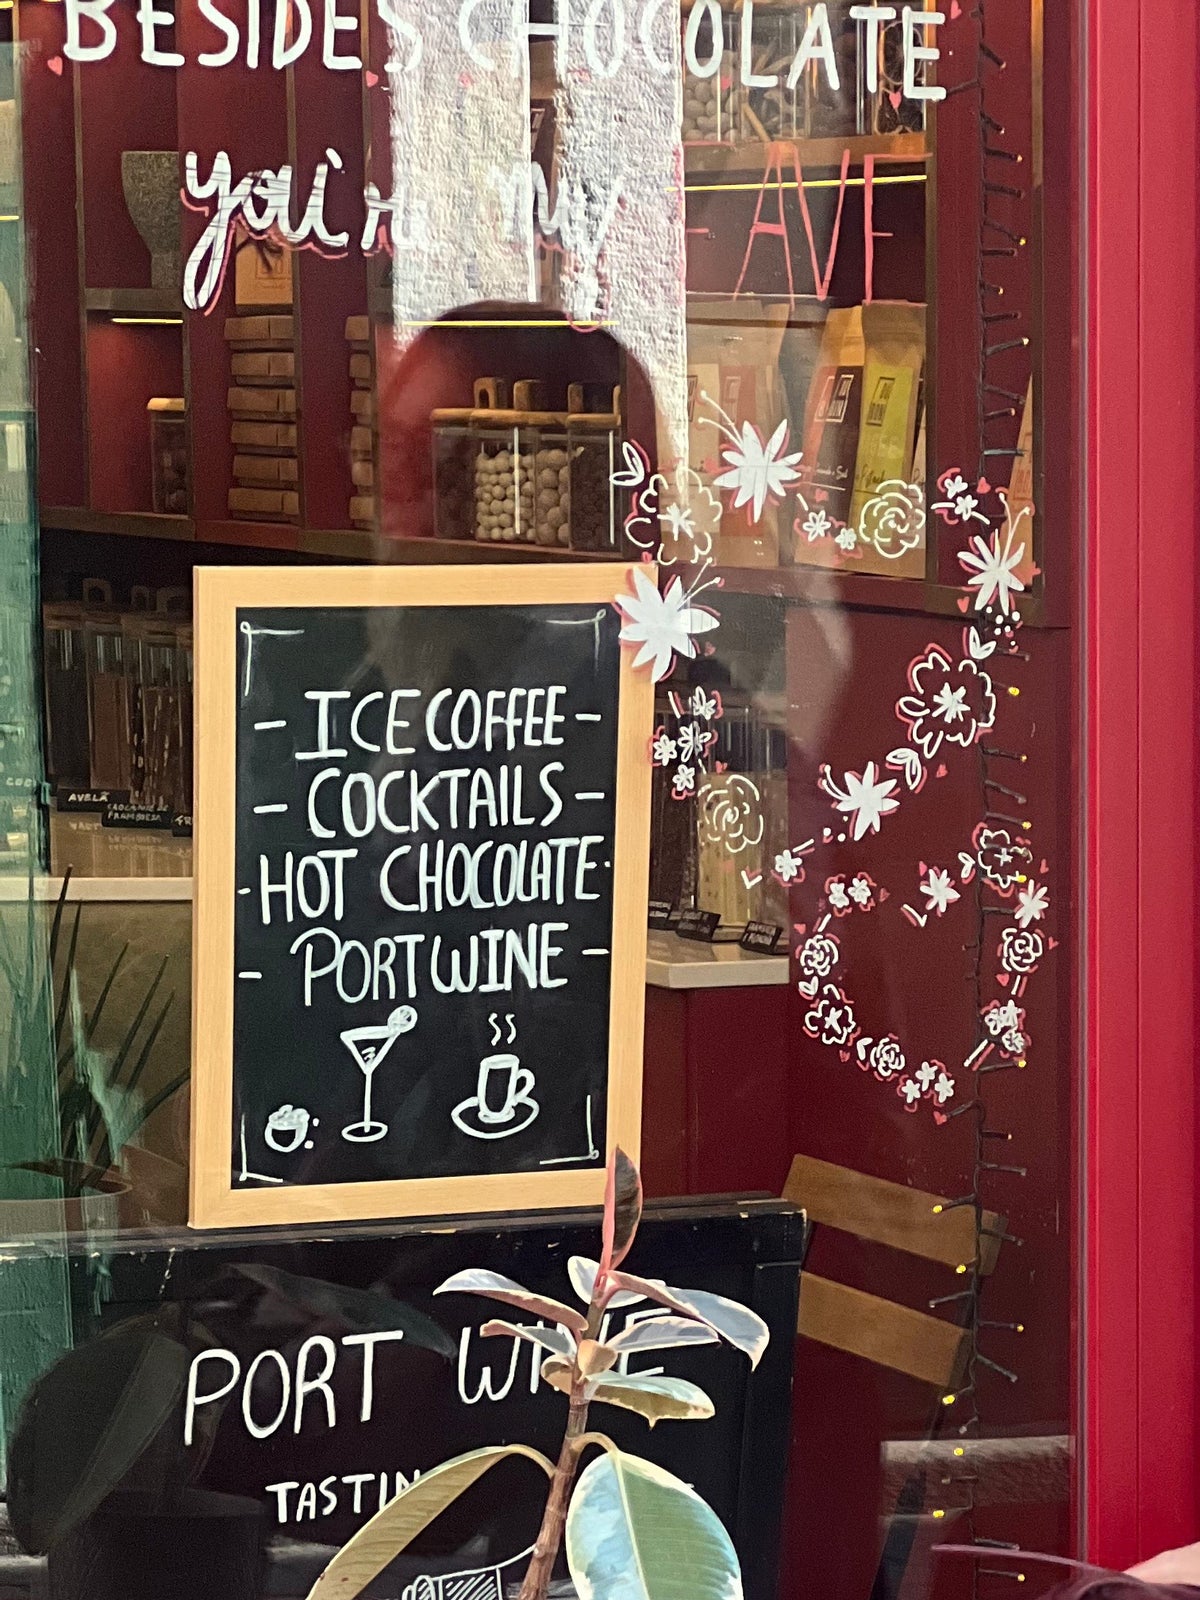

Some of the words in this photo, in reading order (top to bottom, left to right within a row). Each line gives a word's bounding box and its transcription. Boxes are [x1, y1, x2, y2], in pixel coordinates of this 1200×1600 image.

[63, 0, 424, 71] BESIDES
[459, 0, 947, 100] CHOCOLATE
[296, 687, 420, 761] ICE
[425, 685, 566, 752] COFFEE
[307, 762, 563, 839] COCKTAILS
[259, 849, 358, 925] HOT
[380, 836, 604, 913] CHOCOLATE
[184, 1330, 404, 1446] PORT
